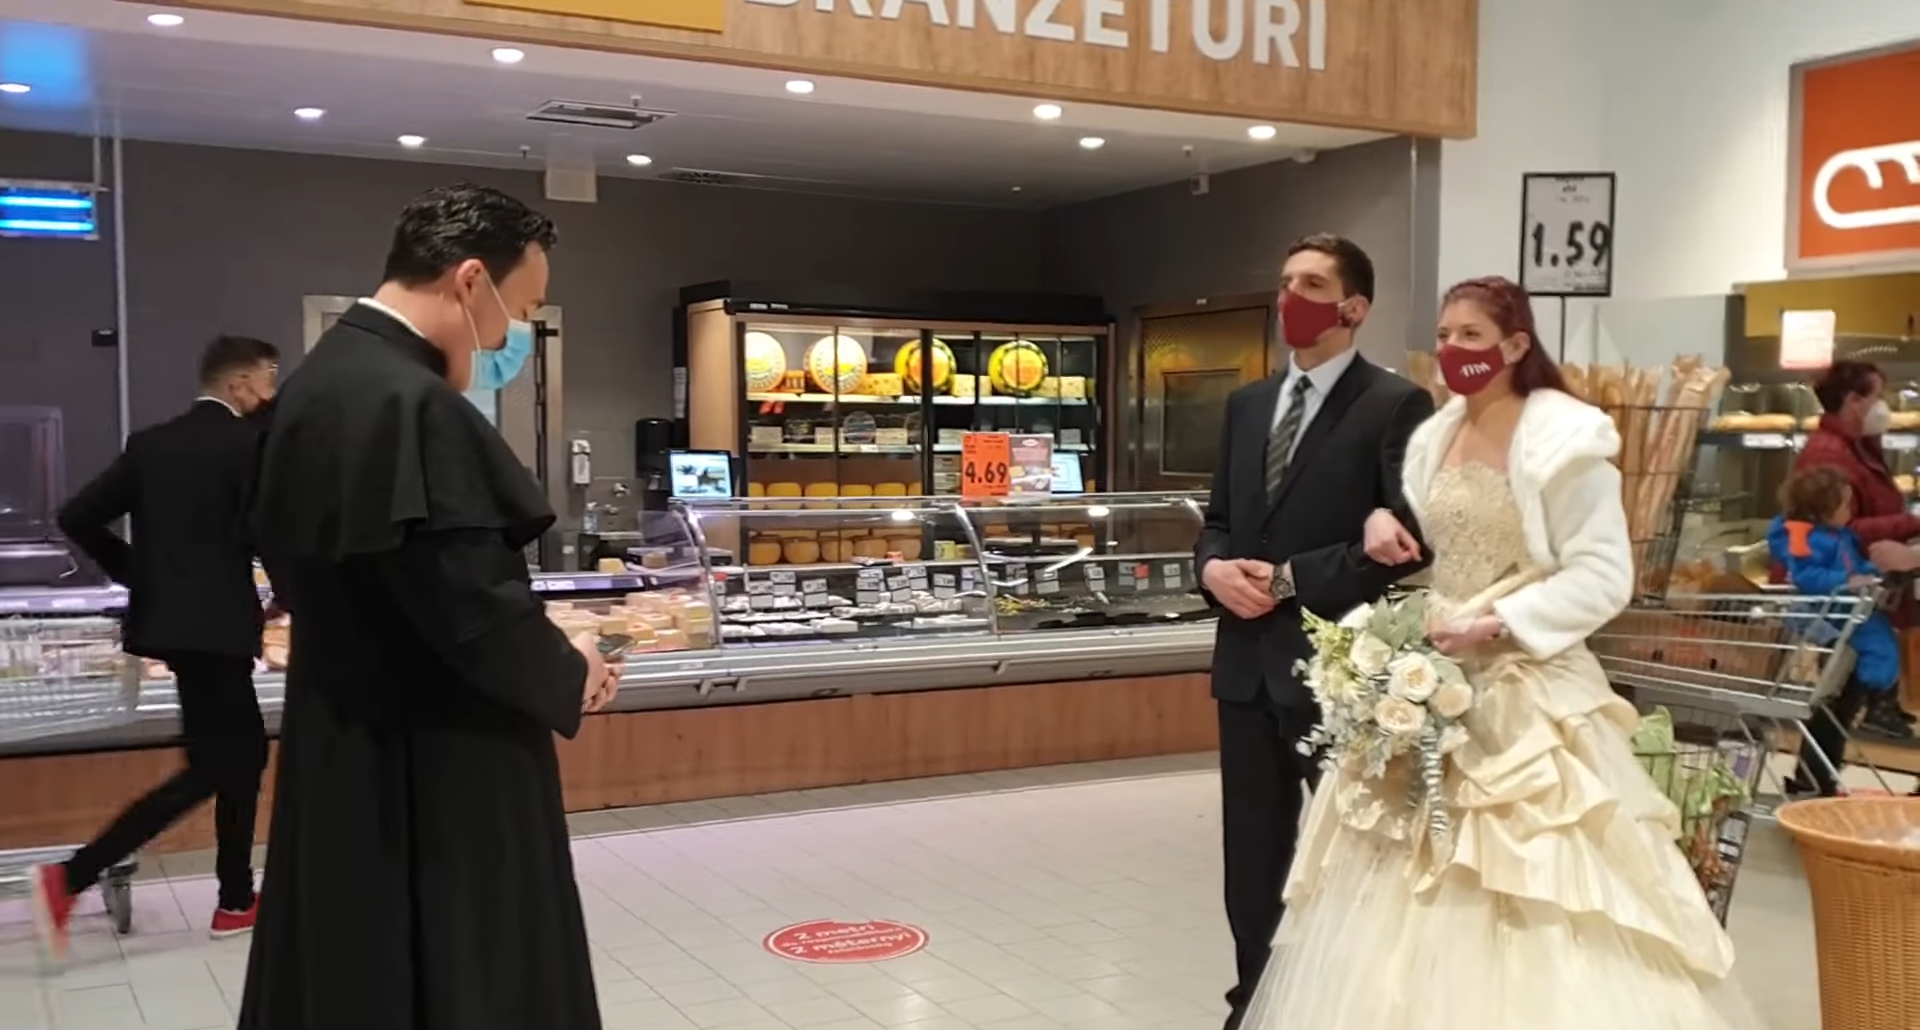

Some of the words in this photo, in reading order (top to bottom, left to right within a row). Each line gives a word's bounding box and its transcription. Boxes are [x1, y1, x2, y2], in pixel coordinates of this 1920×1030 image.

[744, 0, 1326, 70] ZETURI
[1532, 220, 1610, 268] 1.59
[965, 462, 1008, 484] 4.69
[816, 924, 875, 938] metri
